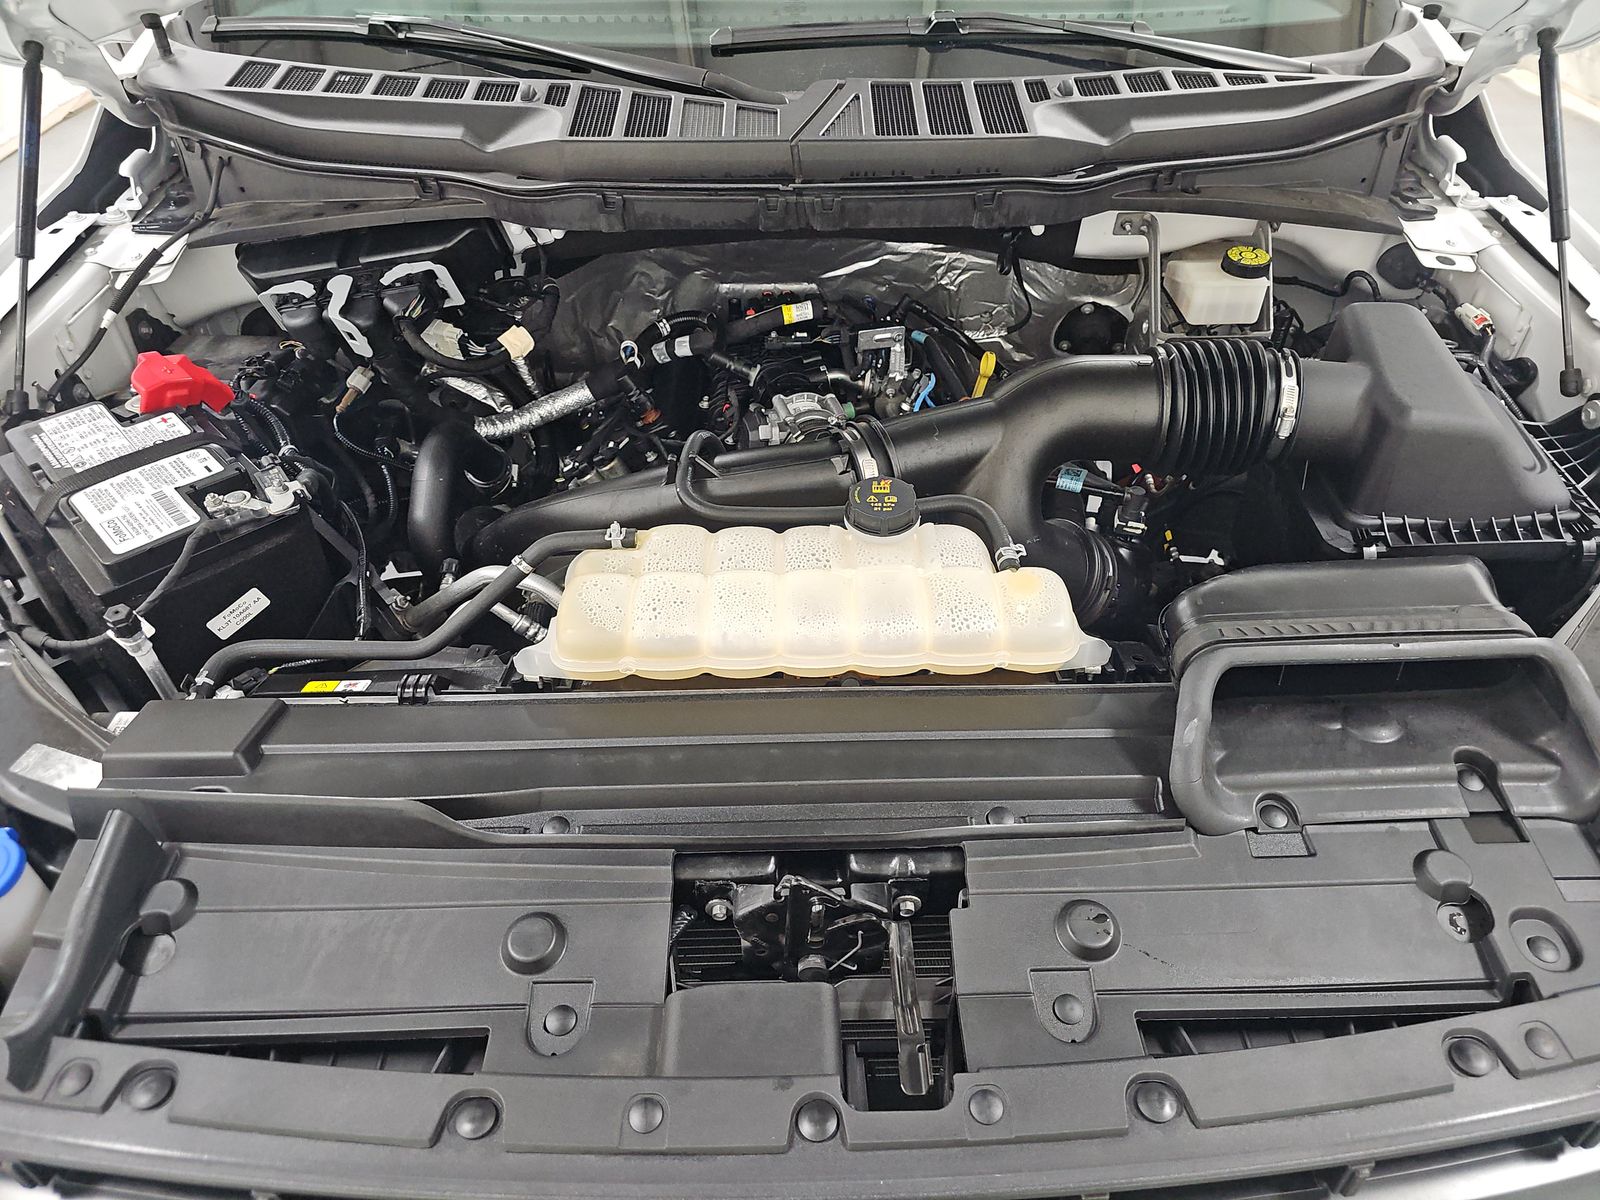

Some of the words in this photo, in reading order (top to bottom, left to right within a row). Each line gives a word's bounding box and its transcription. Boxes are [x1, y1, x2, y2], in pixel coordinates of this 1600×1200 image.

[106, 518, 128, 543] FoMoCo
[222, 600, 247, 620] FoMoCo
[253, 596, 262, 605] AA
